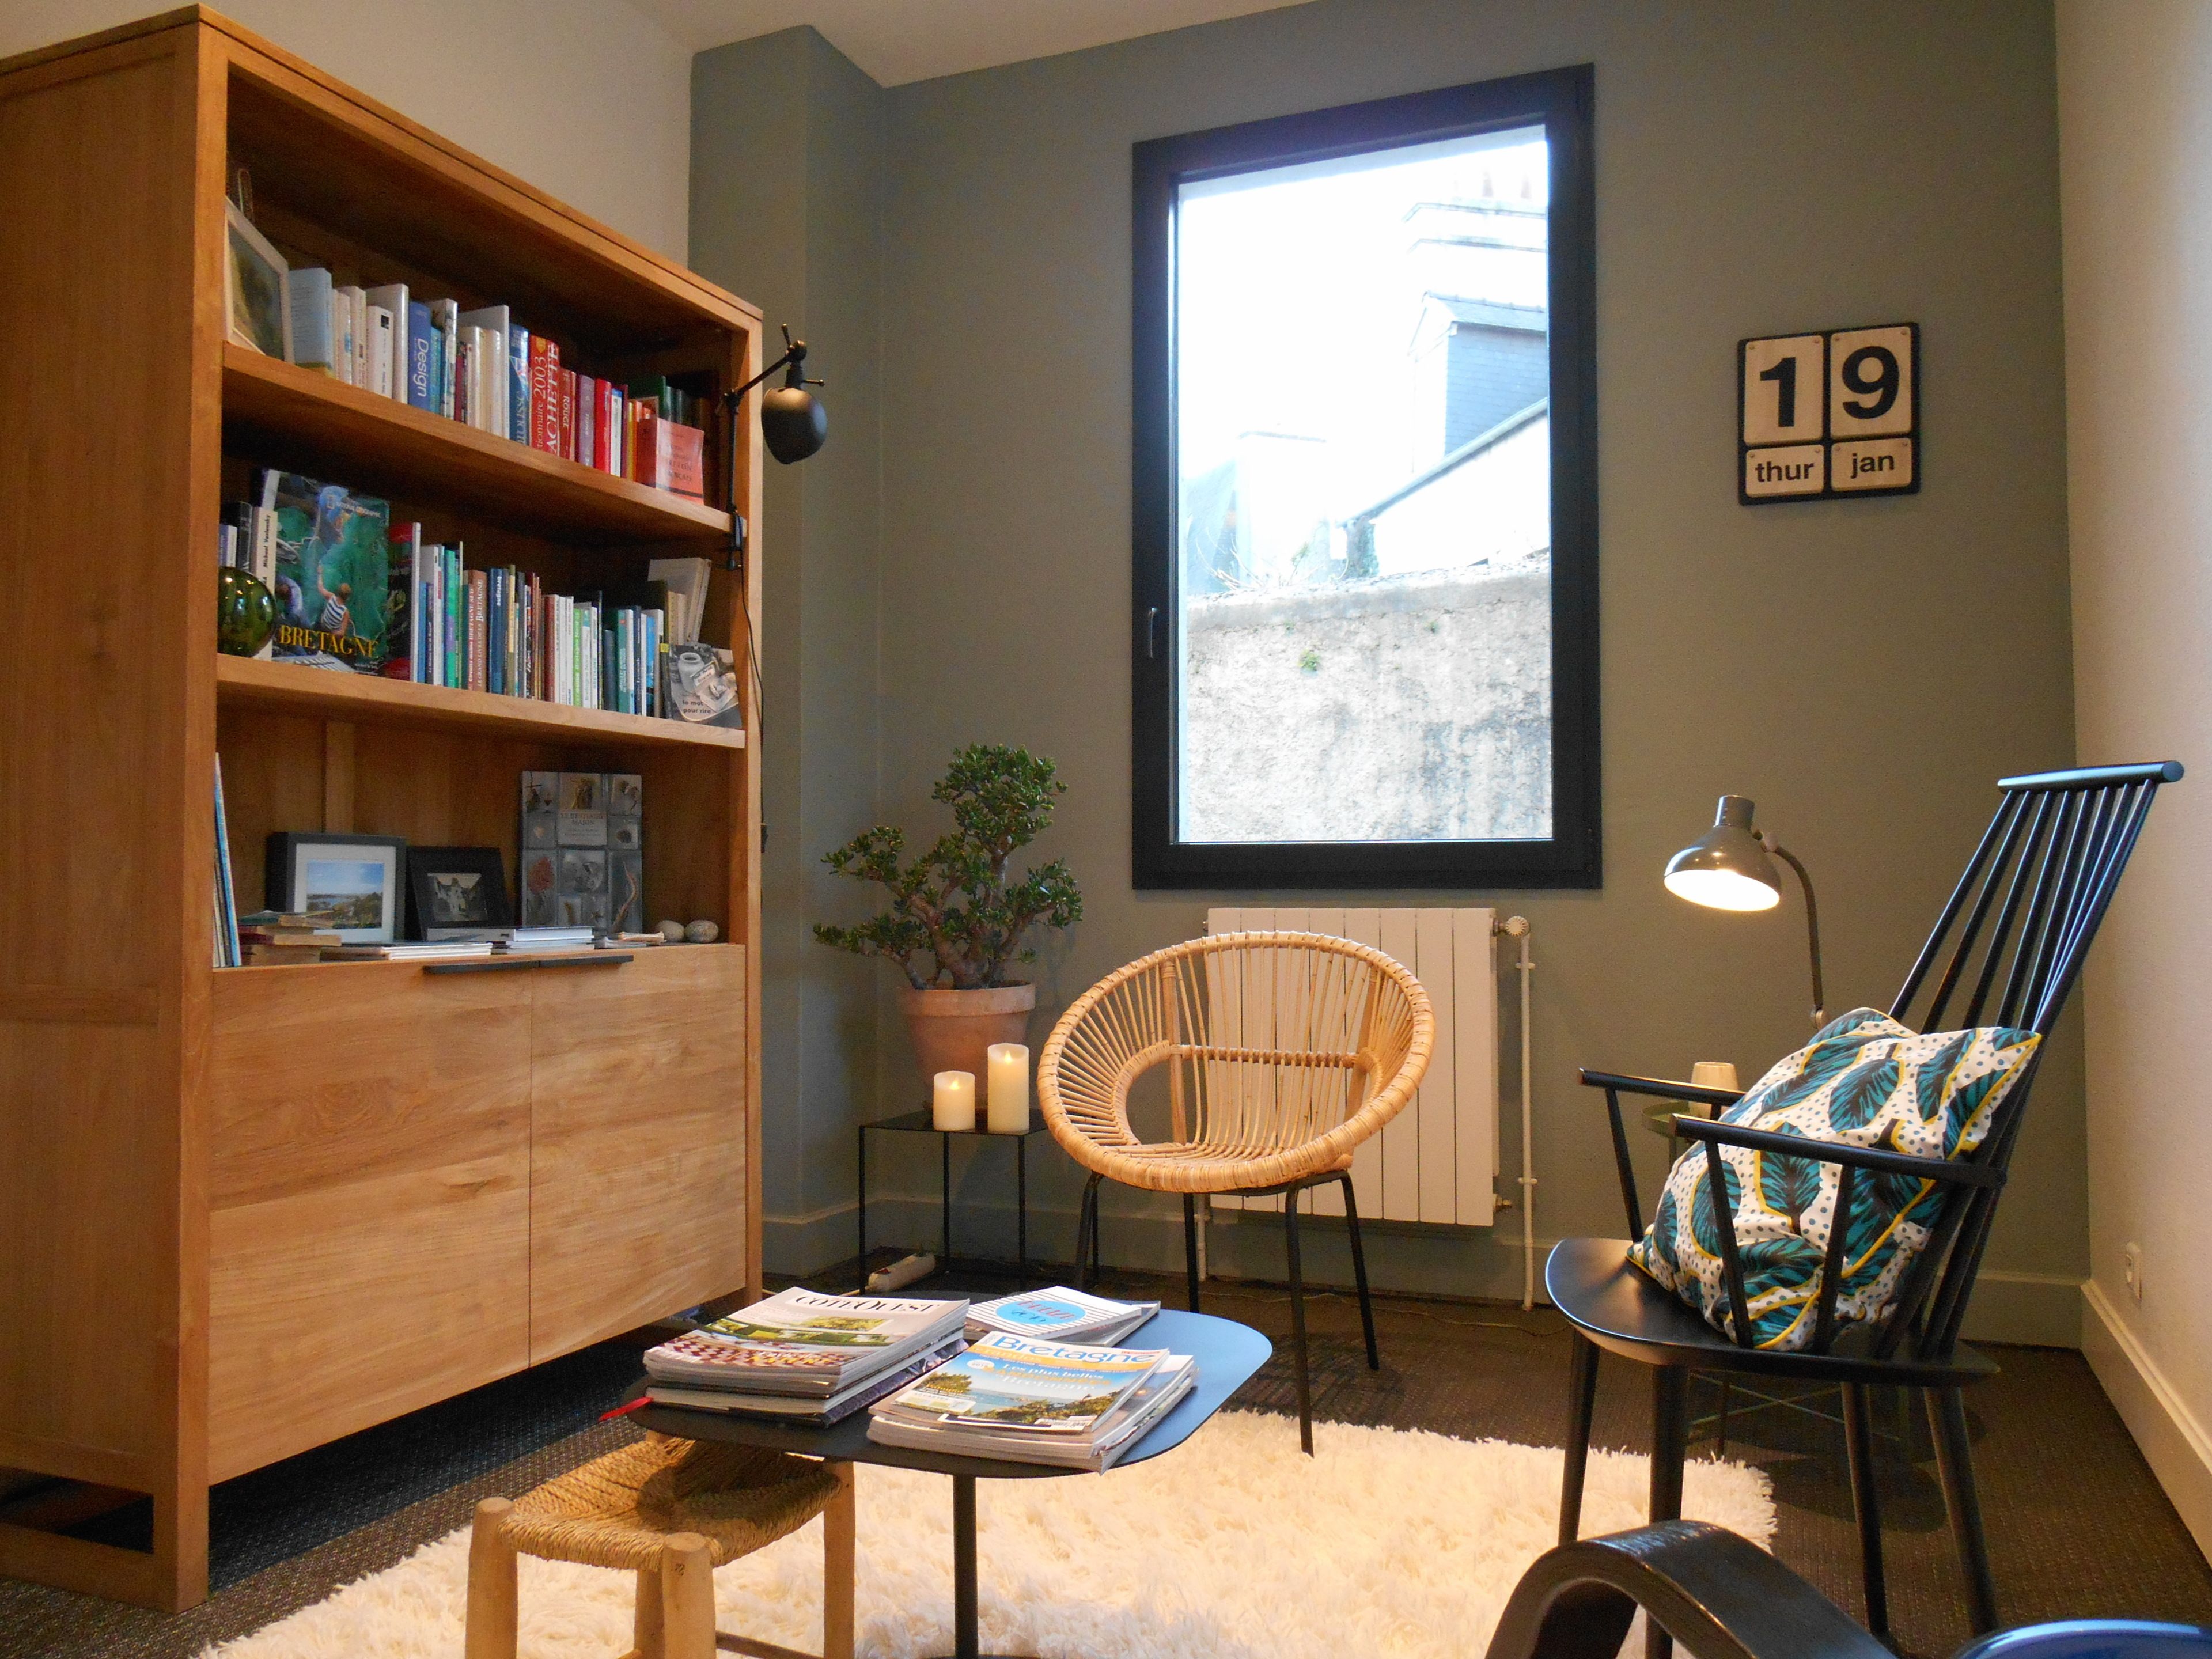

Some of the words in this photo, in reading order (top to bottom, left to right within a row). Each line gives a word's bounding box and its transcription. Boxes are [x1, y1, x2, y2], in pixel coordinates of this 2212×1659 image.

[413, 338, 429, 396] Design
[533, 356, 547, 398] 2003
[546, 343, 558, 454] ACHETTE
[535, 401, 544, 449] tionnaire
[1755, 461, 1814, 483] thur
[1850, 453, 1895, 479] jan
[475, 579, 484, 622] BRETAGNE
[279, 624, 378, 657] BRETAGNE
[991, 1336, 1156, 1363] Bretagne
[1028, 1367, 1058, 1376] plus
[1062, 1371, 1105, 1380] belles
